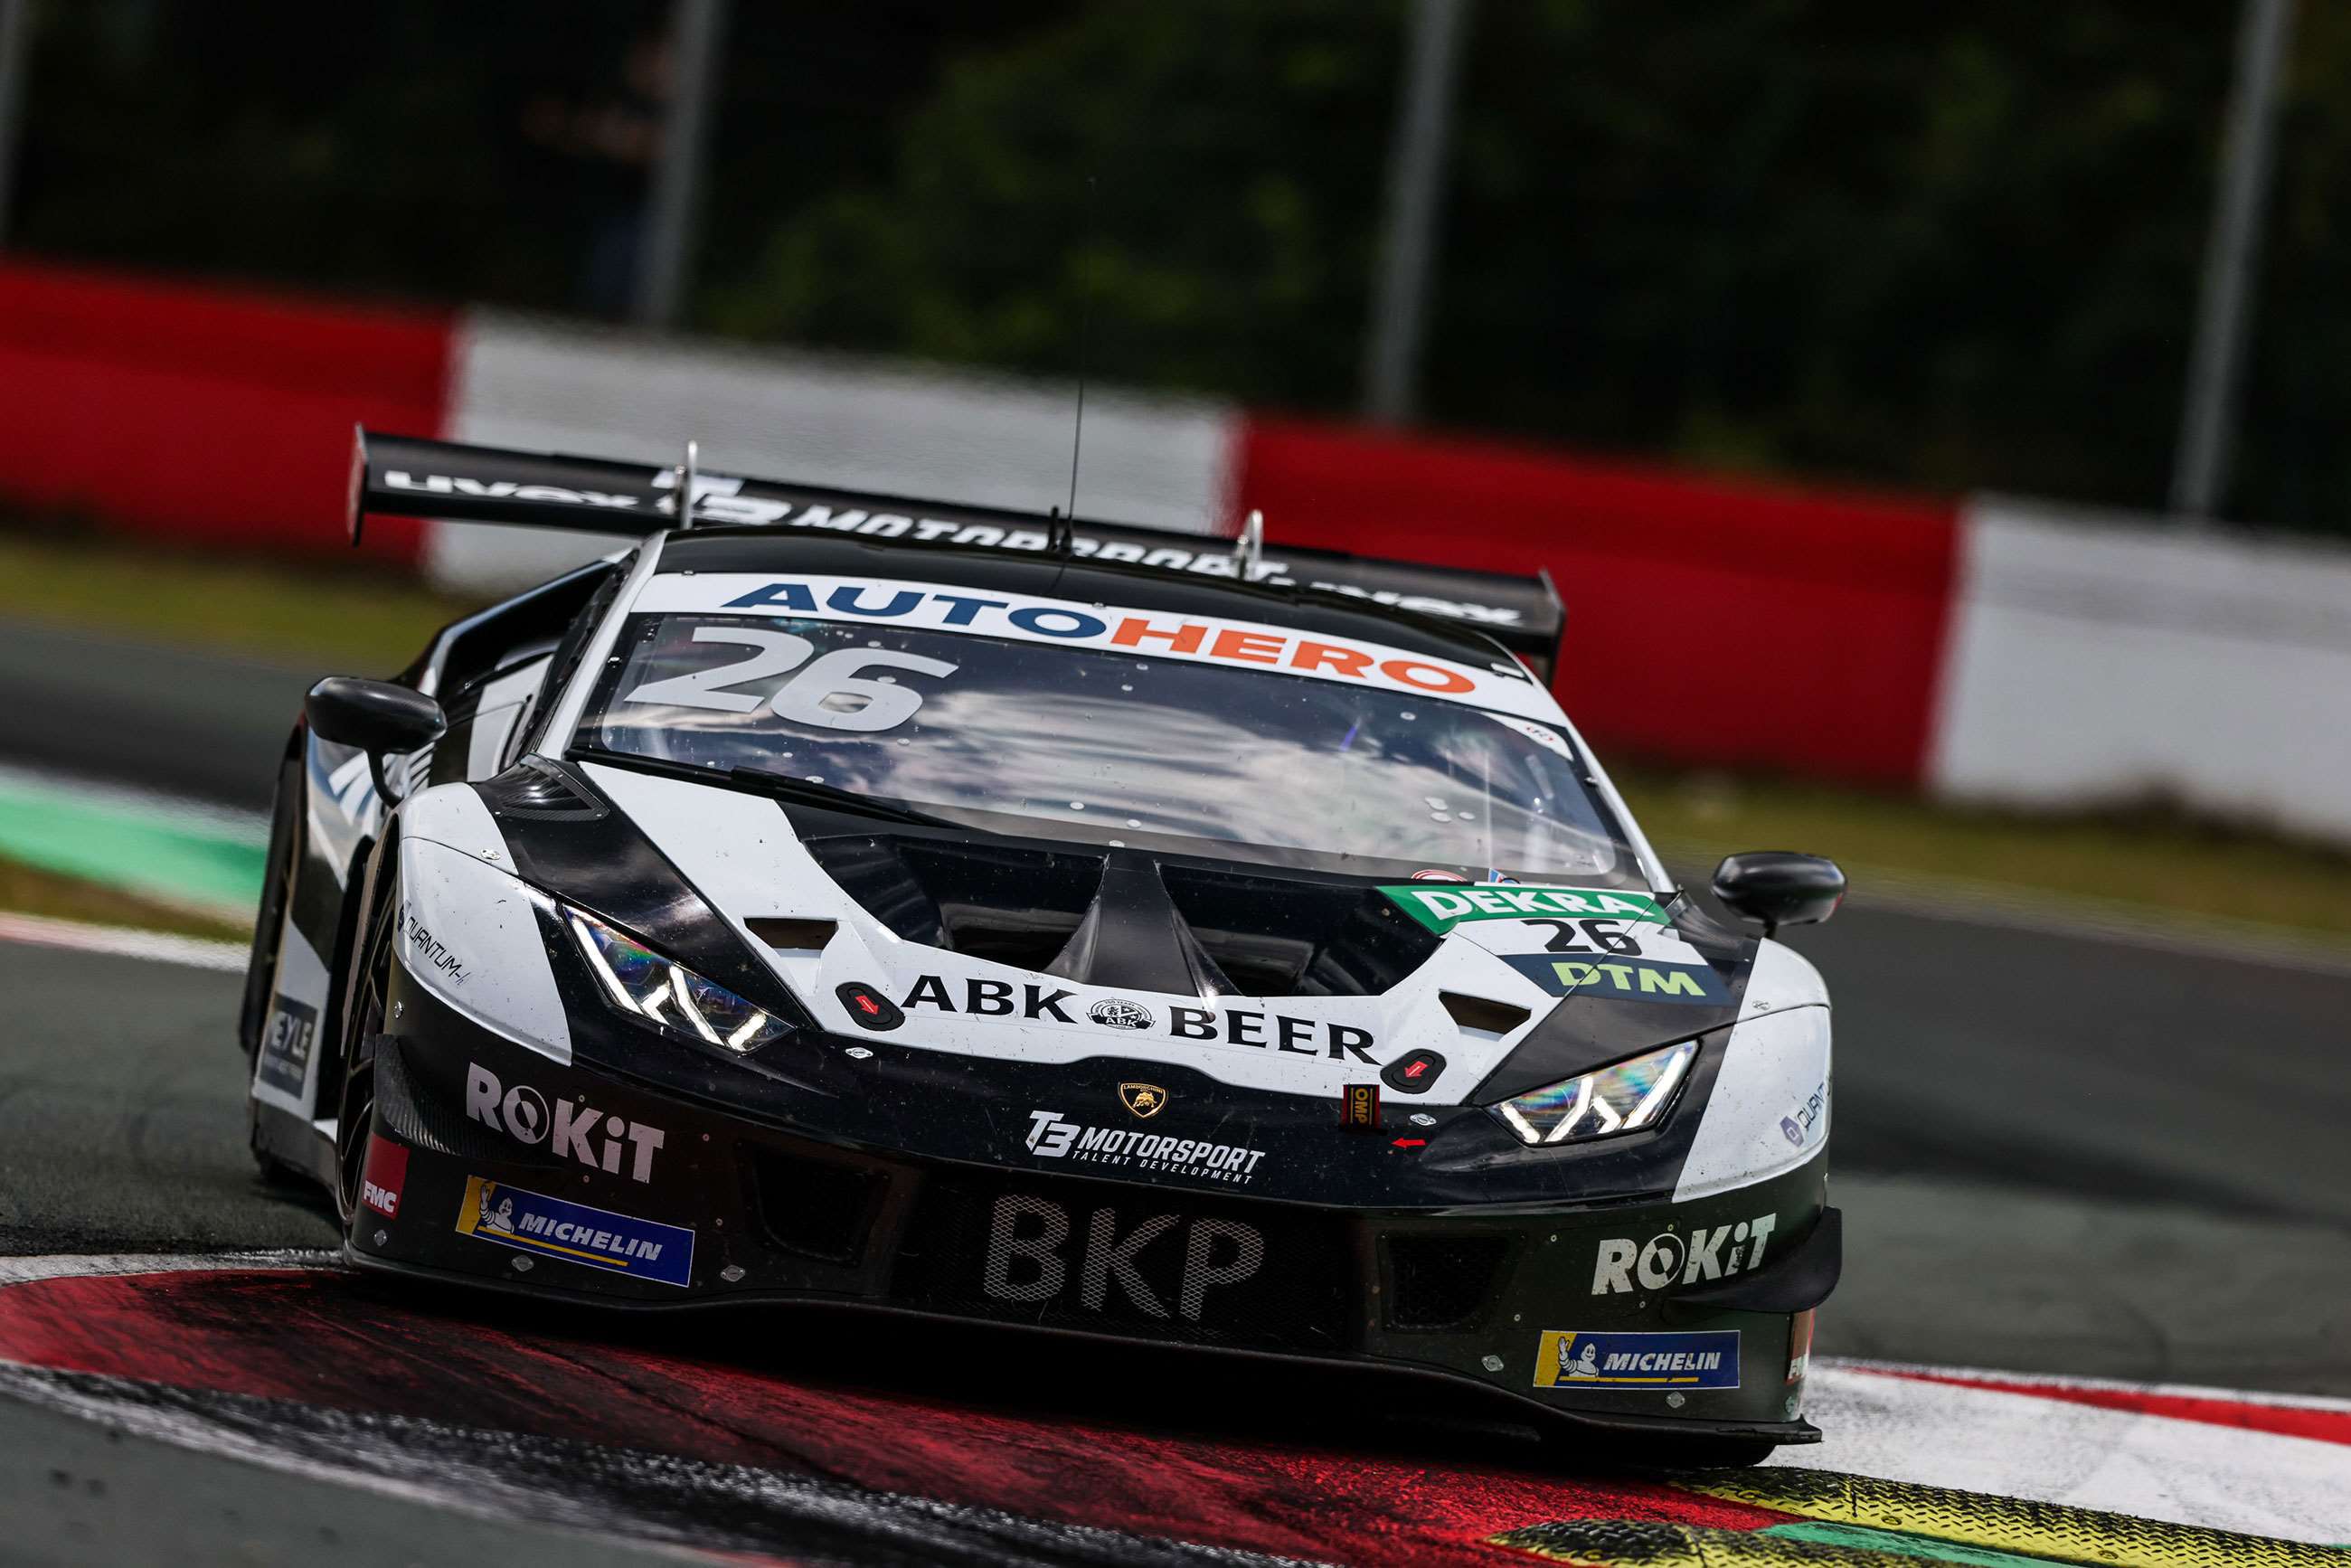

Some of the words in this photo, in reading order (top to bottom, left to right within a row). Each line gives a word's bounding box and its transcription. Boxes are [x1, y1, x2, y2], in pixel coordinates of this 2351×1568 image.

[720, 582, 1476, 695] AUTOHERO
[624, 626, 959, 732] 26
[1411, 890, 1654, 921] DEKRA
[1524, 918, 1642, 957] 26
[1551, 960, 1707, 997] DTM
[901, 975, 1080, 1025] ABK
[1169, 1005, 1383, 1066] BEER
[1105, 1017, 1138, 1028] ABK
[1355, 1087, 1369, 1124] OMP
[1025, 1110, 1081, 1157] T3
[1077, 1127, 1266, 1174] MOTORSPORT
[1072, 1150, 1131, 1166] TALENT
[1138, 1158, 1252, 1185] DEVELOPMENT
[364, 1179, 398, 1214] FMC
[518, 1213, 663, 1262] MICHELIN
[984, 1194, 1264, 1321] BKP
[1603, 1351, 1722, 1372] MICHELIN
